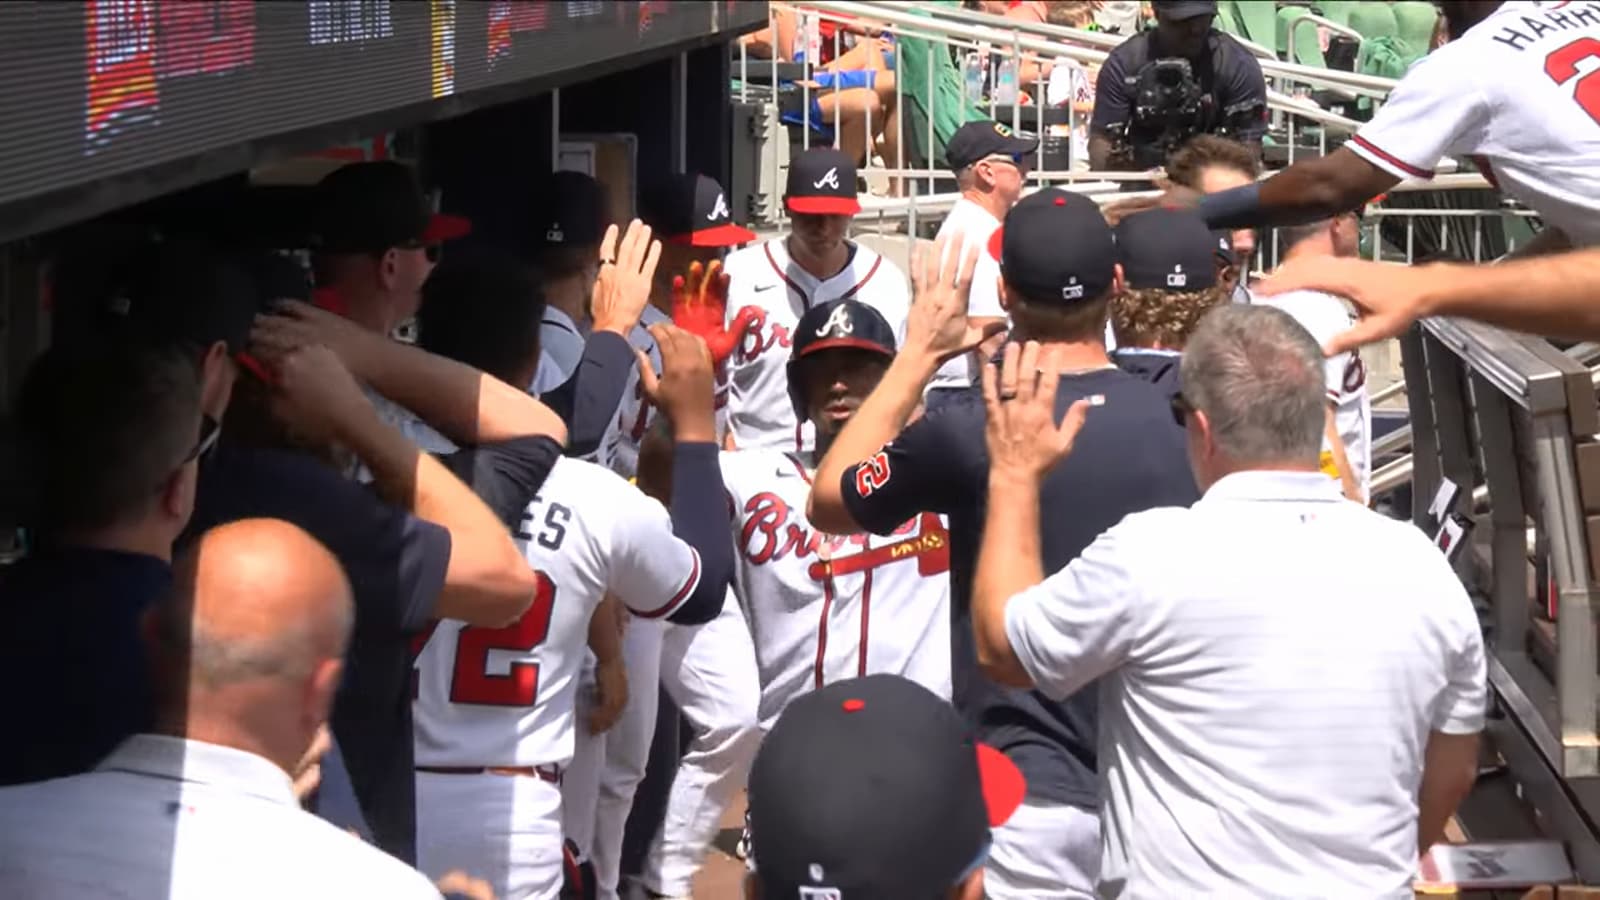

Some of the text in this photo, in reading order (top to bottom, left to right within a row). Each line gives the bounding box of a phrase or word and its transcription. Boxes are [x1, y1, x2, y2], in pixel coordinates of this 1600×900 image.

[813, 167, 840, 190] A
[707, 193, 729, 220] A
[815, 303, 853, 337] A
[412, 569, 557, 707] 2
